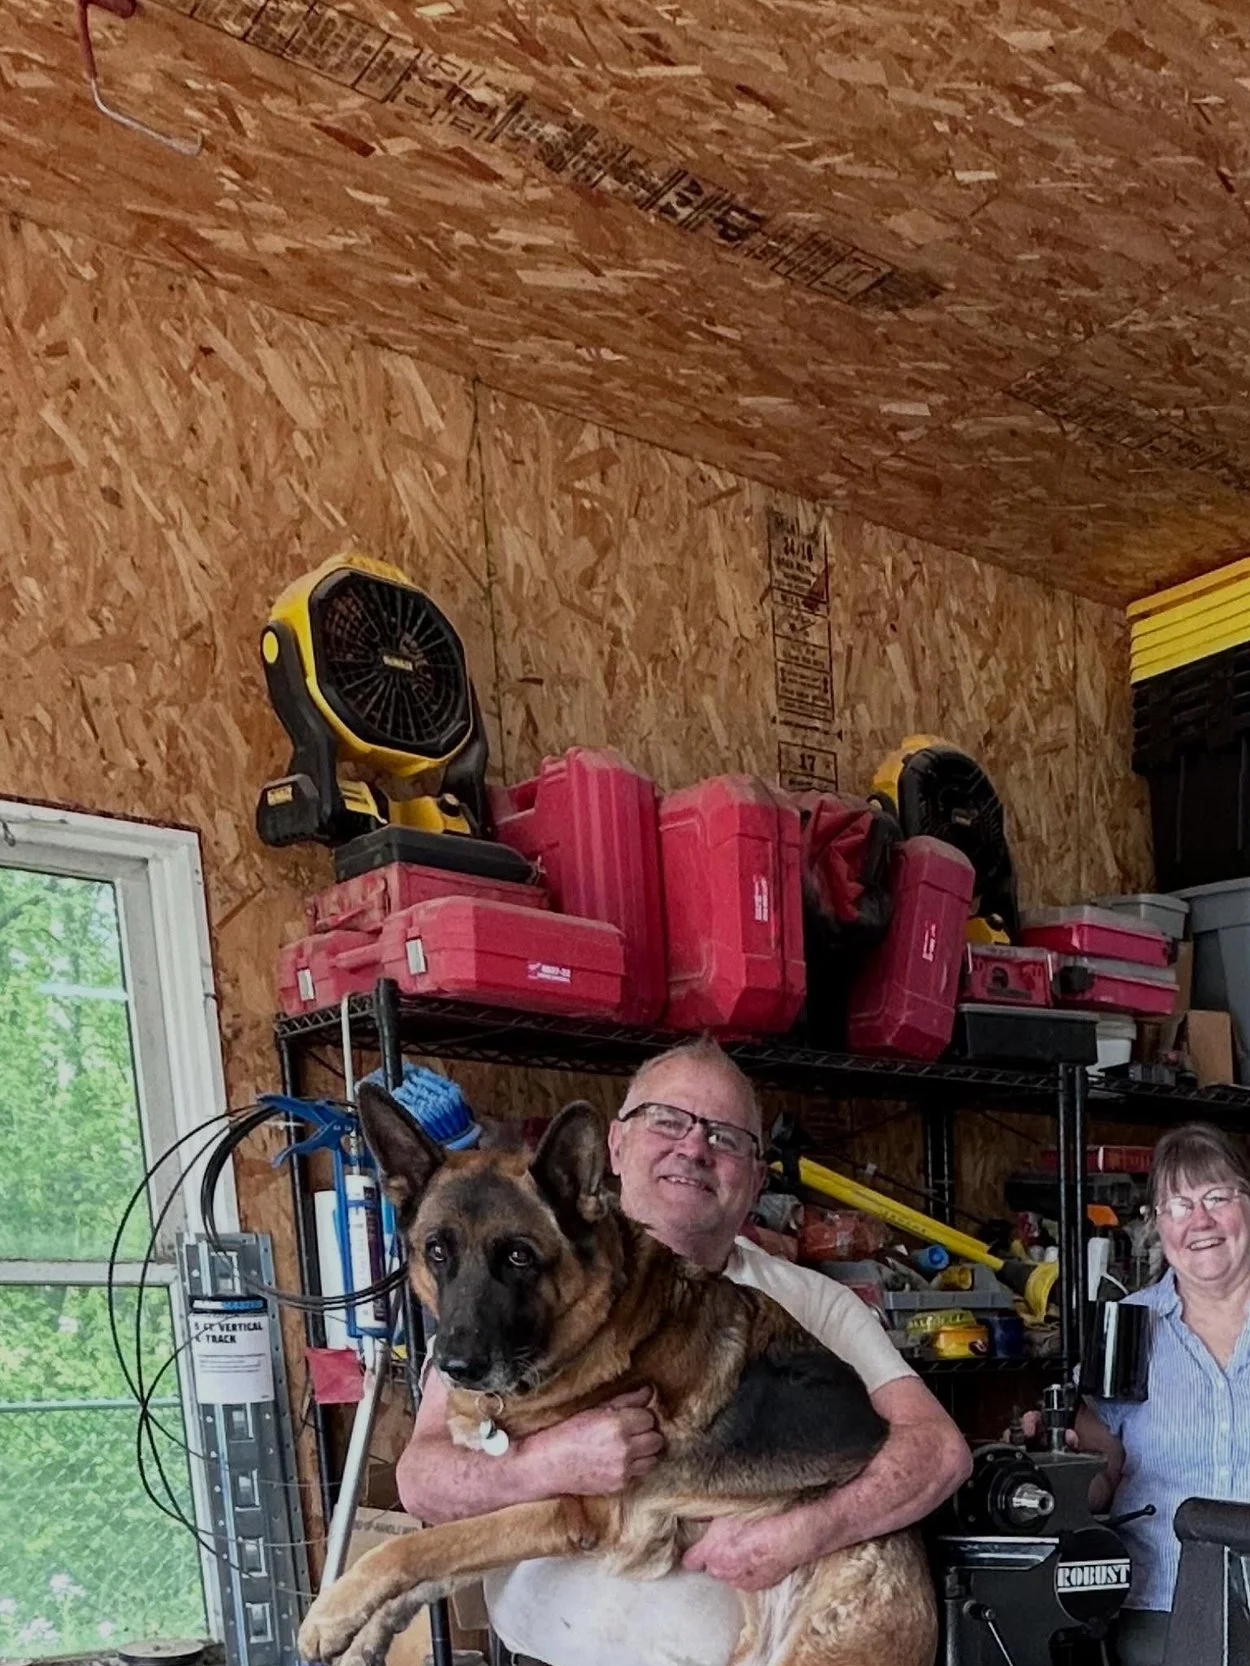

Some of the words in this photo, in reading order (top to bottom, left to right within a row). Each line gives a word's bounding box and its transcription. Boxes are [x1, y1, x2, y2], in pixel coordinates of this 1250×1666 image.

[799, 753, 816, 772] 17
[219, 1321, 264, 1333] VERTICAL
[1057, 1564, 1130, 1588] ROBUST
